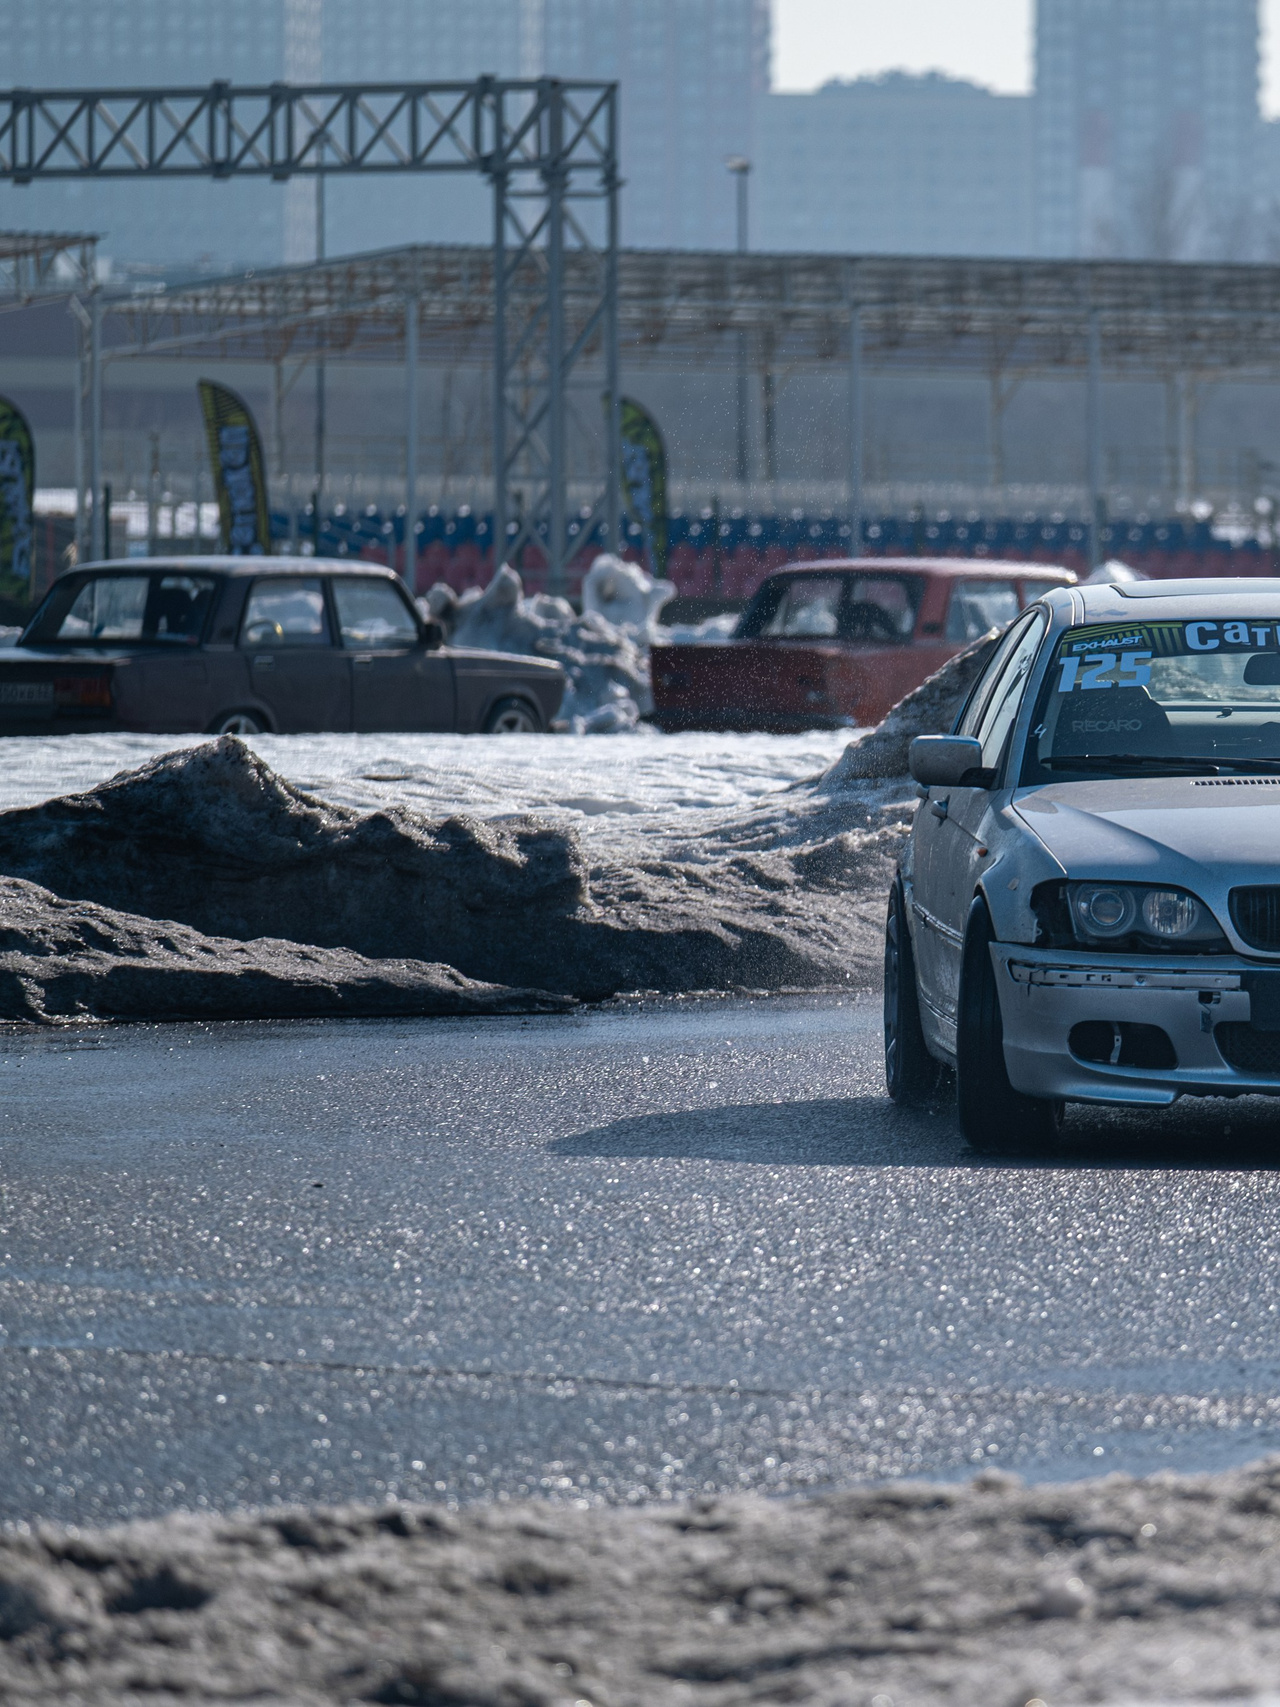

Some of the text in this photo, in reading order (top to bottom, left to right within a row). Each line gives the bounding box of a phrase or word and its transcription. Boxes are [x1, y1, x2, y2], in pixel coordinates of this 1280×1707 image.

[1072, 635, 1143, 652] EXHAUST
[1058, 651, 1152, 692] 125
[1072, 719, 1142, 732] RECARO
